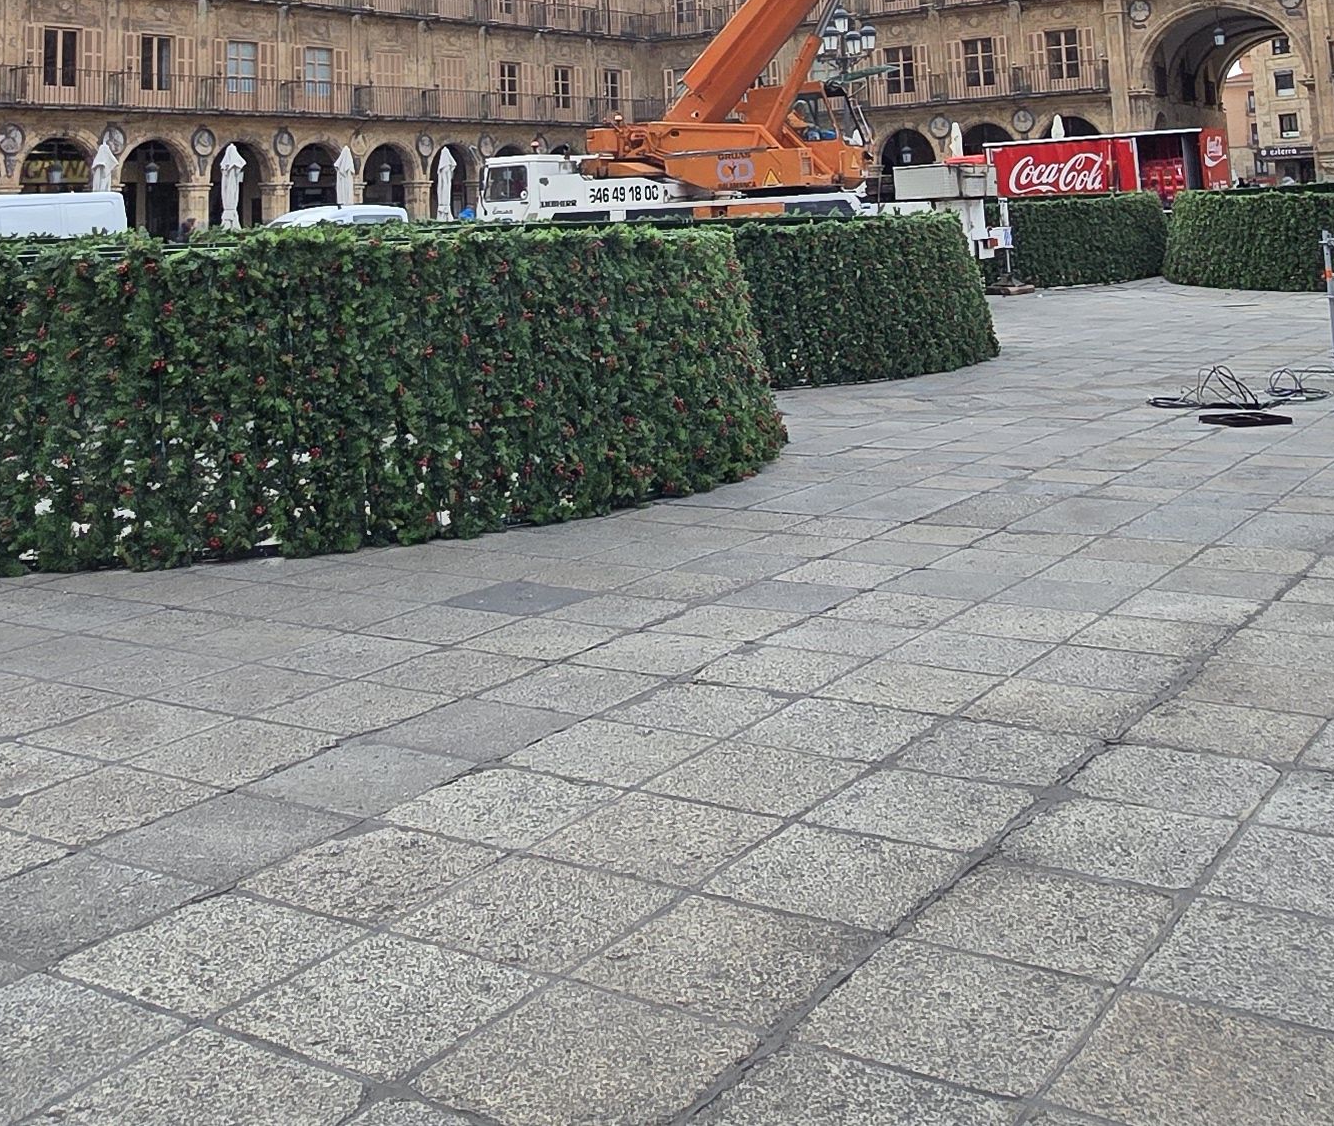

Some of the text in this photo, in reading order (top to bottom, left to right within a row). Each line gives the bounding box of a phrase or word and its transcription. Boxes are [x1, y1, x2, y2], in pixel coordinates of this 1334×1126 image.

[717, 152, 752, 161] GRUAS
[612, 186, 626, 202] 49
[628, 186, 642, 201] 18
